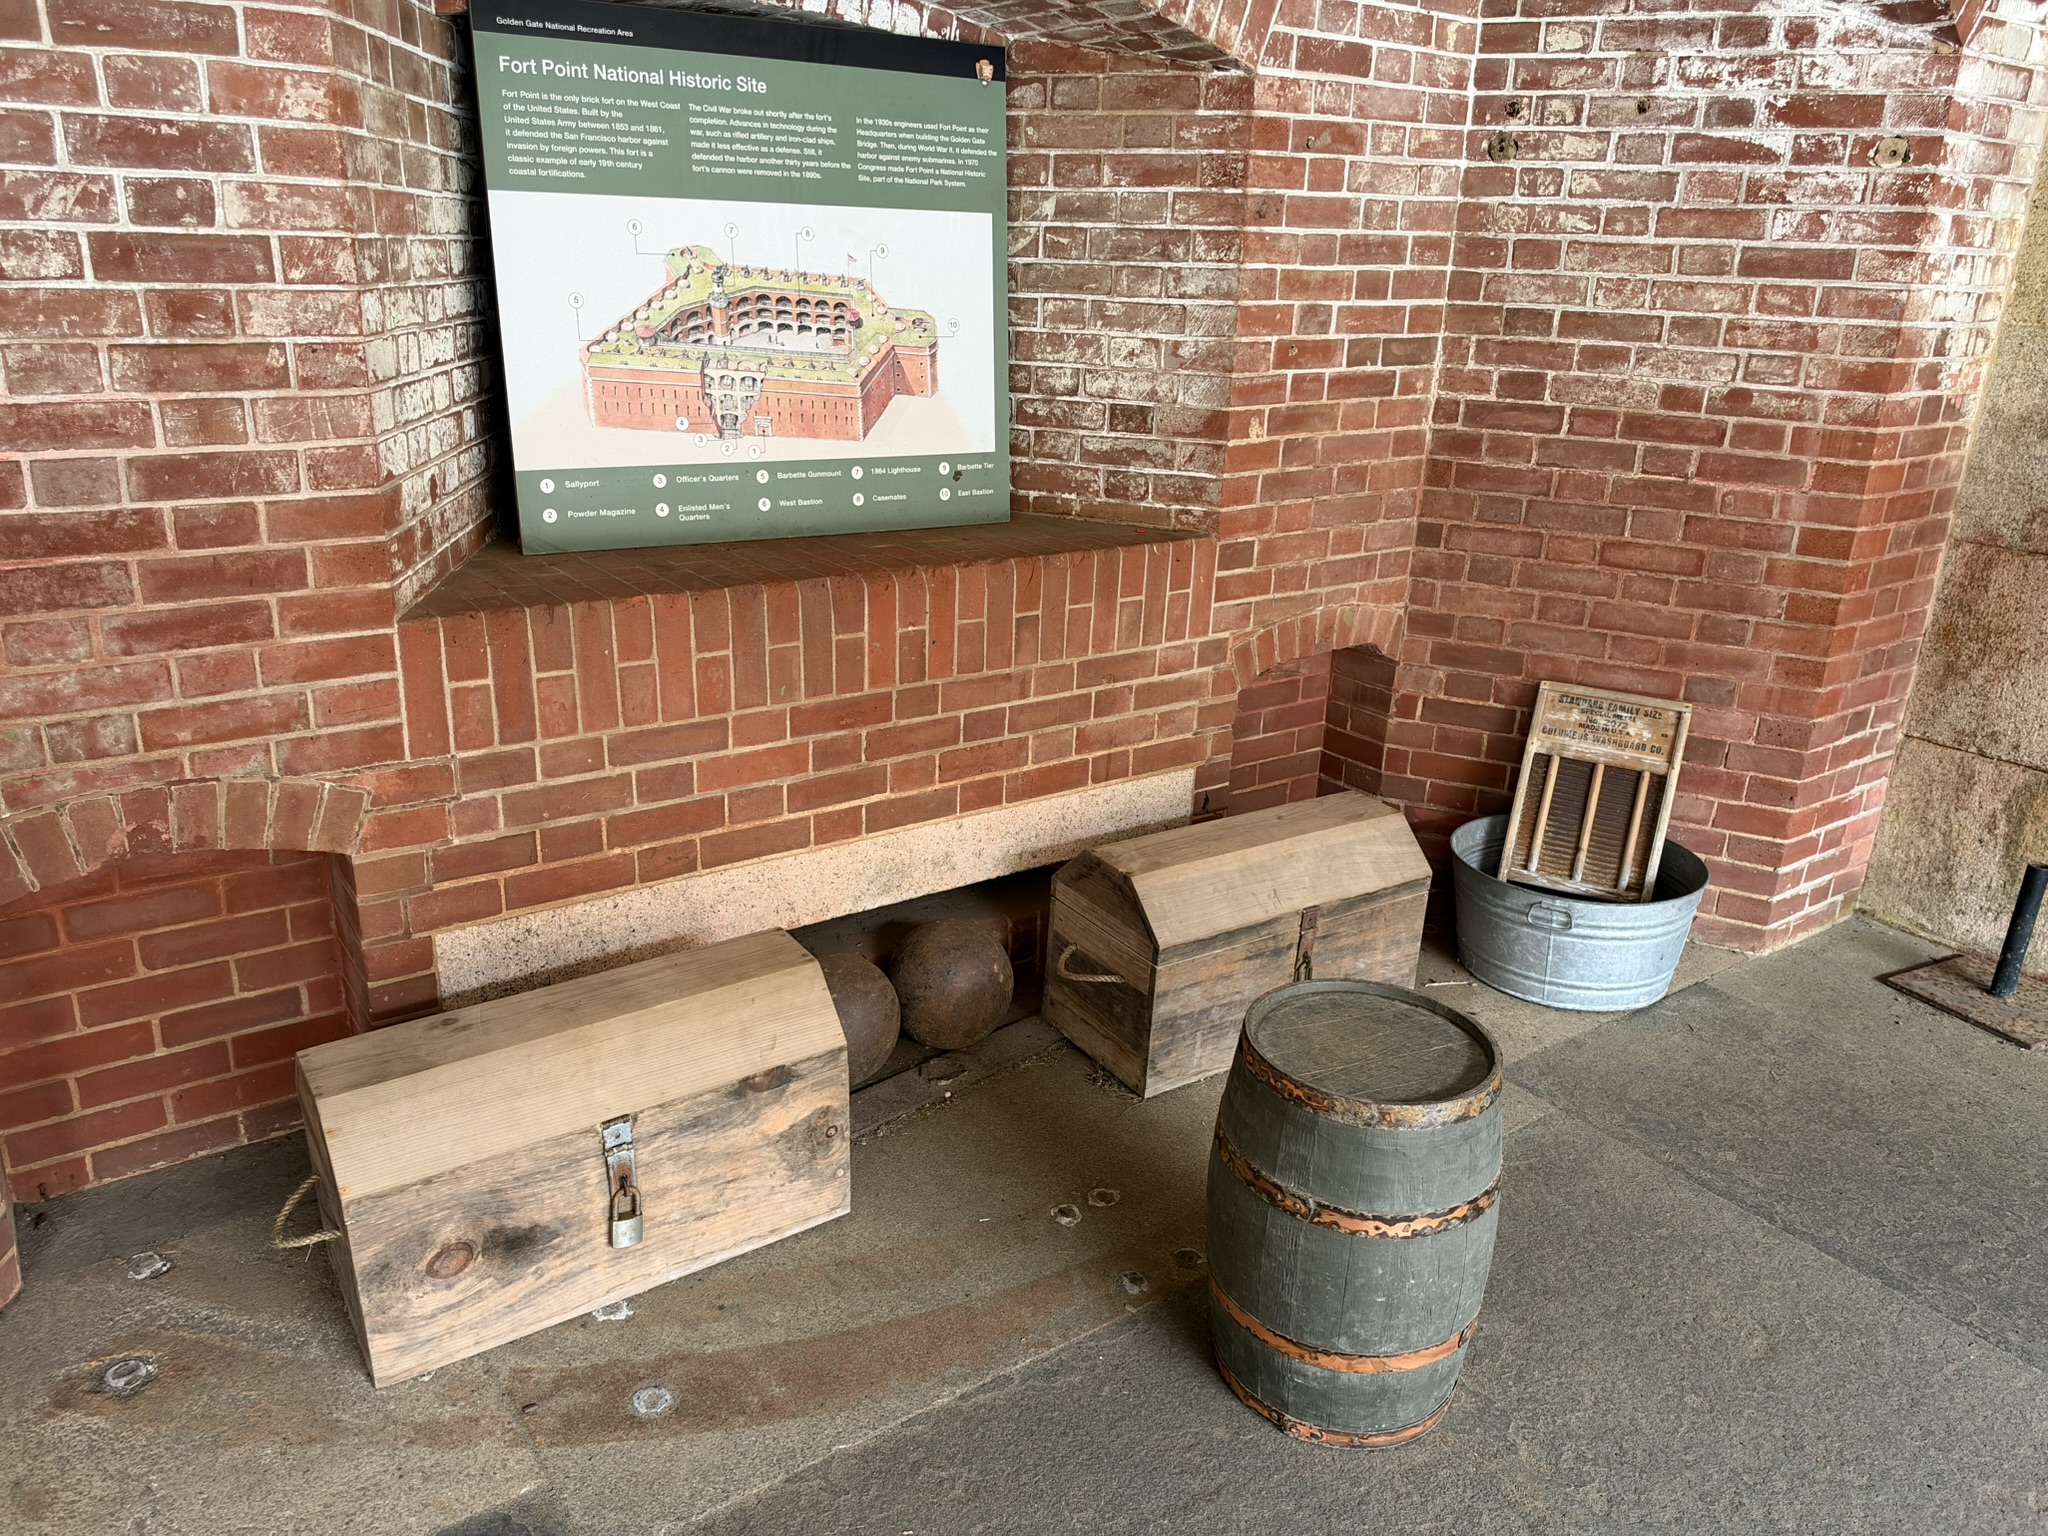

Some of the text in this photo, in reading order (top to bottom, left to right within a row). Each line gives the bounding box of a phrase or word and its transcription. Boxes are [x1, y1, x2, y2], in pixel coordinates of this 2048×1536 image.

[496, 16, 633, 36] Golden Gate National Recreation Area
[499, 55, 767, 93] Fort Point National Historic Site
[502, 88, 518, 97] Fort
[520, 90, 540, 99] Point
[541, 91, 548, 99] is
[550, 92, 562, 100] the
[563, 93, 579, 103] only
[581, 95, 600, 103] brick
[601, 96, 614, 104] fort
[627, 98, 638, 106] the
[640, 99, 658, 108] West
[660, 101, 680, 109] Coast
[503, 101, 623, 118] of the United States. Built by the
[688, 103, 701, 111] The
[703, 104, 717, 112] Civil
[718, 105, 732, 113] War
[733, 107, 752, 115] broke
[765, 109, 787, 119] shortly
[788, 111, 803, 119] after
[804, 112, 814, 120] the
[816, 113, 831, 121] fort's
[504, 115, 529, 124] United
[531, 116, 555, 125] States
[557, 118, 576, 128] Army
[578, 120, 609, 129] between
[611, 122, 629, 130] 1853
[630, 123, 644, 131] and
[689, 115, 728, 127] completion.
[729, 118, 761, 127] Advances
[770, 121, 805, 132] technology
[806, 124, 826, 134] during
[894, 119, 922, 129] engineers
[924, 121, 938, 129] used
[512, 128, 548, 138] defended
[550, 131, 562, 139] the
[564, 132, 578, 140] San
[580, 133, 616, 142] Francisco
[618, 135, 641, 144] harbor
[643, 137, 668, 147] against
[857, 128, 897, 139] Headquarters
[916, 132, 938, 142] building
[506, 140, 538, 150] invasion
[540, 143, 550, 152] by
[551, 143, 577, 154] foreign
[579, 147, 608, 155] powers.
[609, 147, 625, 155] This
[626, 148, 639, 156] fort
[857, 139, 878, 149] Bridge.
[880, 141, 896, 149] Then,
[898, 142, 917, 151] during
[961, 147, 987, 155] defended
[507, 153, 643, 170] classic example of early 19th century
[857, 151, 877, 159] harbor
[879, 152, 900, 161] against
[901, 155, 921, 163] enemy
[922, 155, 956, 164] submarines.
[508, 166, 586, 178] coastal fortifications.
[950, 321, 957, 329] 10
[808, 470, 841, 478] Gunmount
[888, 467, 921, 475] Lighthouse
[564, 480, 600, 489] Sallyport
[567, 509, 597, 518] Powder
[600, 508, 636, 517] Magazine
[678, 504, 707, 512] Enlisted
[1558, 694, 1663, 719] STANDARD FAMILY SIZE
[1578, 723, 1601, 731] MADE
[1592, 735, 1647, 751] WASHBOARD
[1649, 745, 1665, 755] CO.
